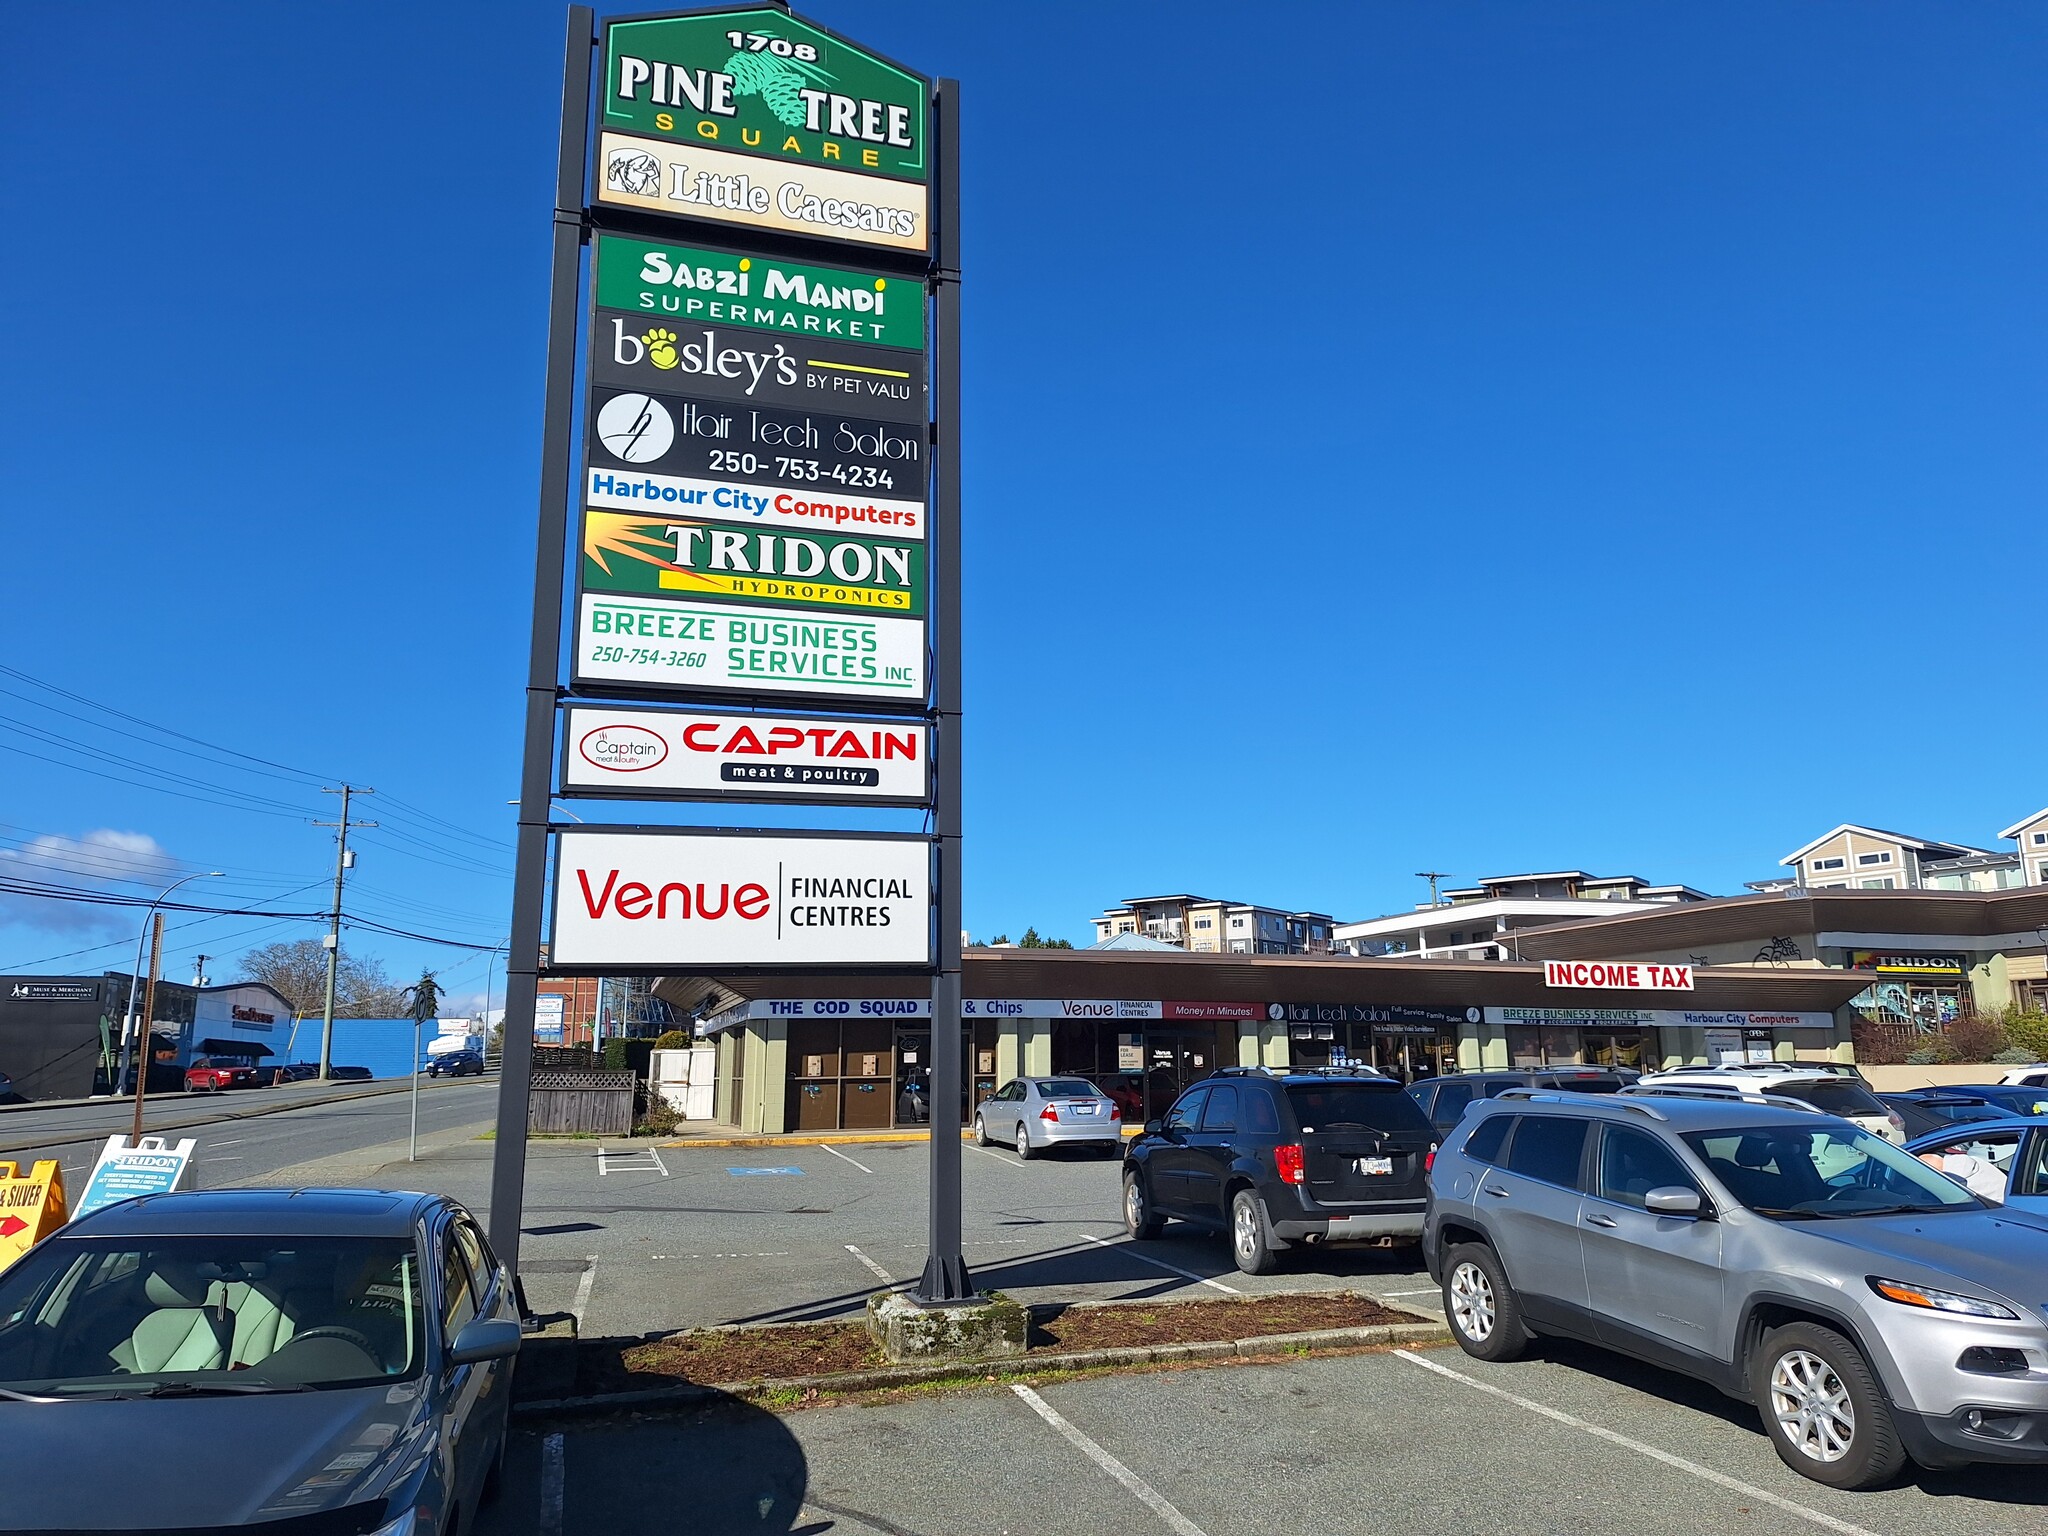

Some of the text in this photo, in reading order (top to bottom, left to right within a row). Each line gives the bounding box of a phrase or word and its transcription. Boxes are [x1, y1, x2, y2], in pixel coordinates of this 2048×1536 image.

[726, 30, 818, 63] 1708
[618, 55, 914, 149] PINE TREE
[655, 113, 879, 166] SQUARE
[667, 162, 916, 238] Little Caesars
[639, 292, 885, 340] SUPERMARKET
[806, 373, 911, 400] BY PET VALU
[682, 402, 732, 440] Hair
[748, 410, 818, 449] Tech
[832, 422, 918, 461] Salon
[708, 450, 894, 490] 250- 753-4234
[592, 474, 916, 527] Harbour City Computers
[663, 523, 912, 587] TRIDON
[732, 578, 904, 606] HYDROPONICS
[592, 610, 877, 653] BREEZE BUSINESS
[592, 646, 707, 669] 250-754-3260
[727, 647, 917, 682] SERVICES INC.
[595, 738, 657, 763] Captain
[682, 723, 916, 761] CAPTAIN
[596, 755, 612, 763] meat
[732, 765, 868, 784] meat & poultry
[576, 869, 771, 920] Venue
[791, 877, 913, 899] FINANCIAL
[790, 906, 891, 927] CENTRES
[1876, 956, 1960, 968] TRIDON
[1549, 963, 1691, 988] INCOME TAX
[769, 1001, 804, 1014] THE
[813, 1001, 850, 1014] COD
[860, 1001, 918, 1016] SQUAD
[965, 1001, 976, 1014] &
[986, 1001, 1023, 1016] Chips
[1062, 1001, 1114, 1016] Venue
[1120, 1001, 1154, 1009] FINANCIAL
[1121, 1009, 1148, 1017] CENTRES
[1175, 1006, 1254, 1016] Money In Minutes!
[1288, 1004, 1391, 1022] Hair Tech Salon
[1426, 1012, 1445, 1020] Family
[1503, 1009, 1541, 1019] BREEZE
[1543, 1009, 1591, 1020] BUSINESS
[1594, 1010, 1639, 1020] SERVICES
[1684, 1013, 1800, 1026] Harbour City Computers
[119, 1156, 179, 1167] TRIDON
[7, 1184, 42, 1208] SILVER
